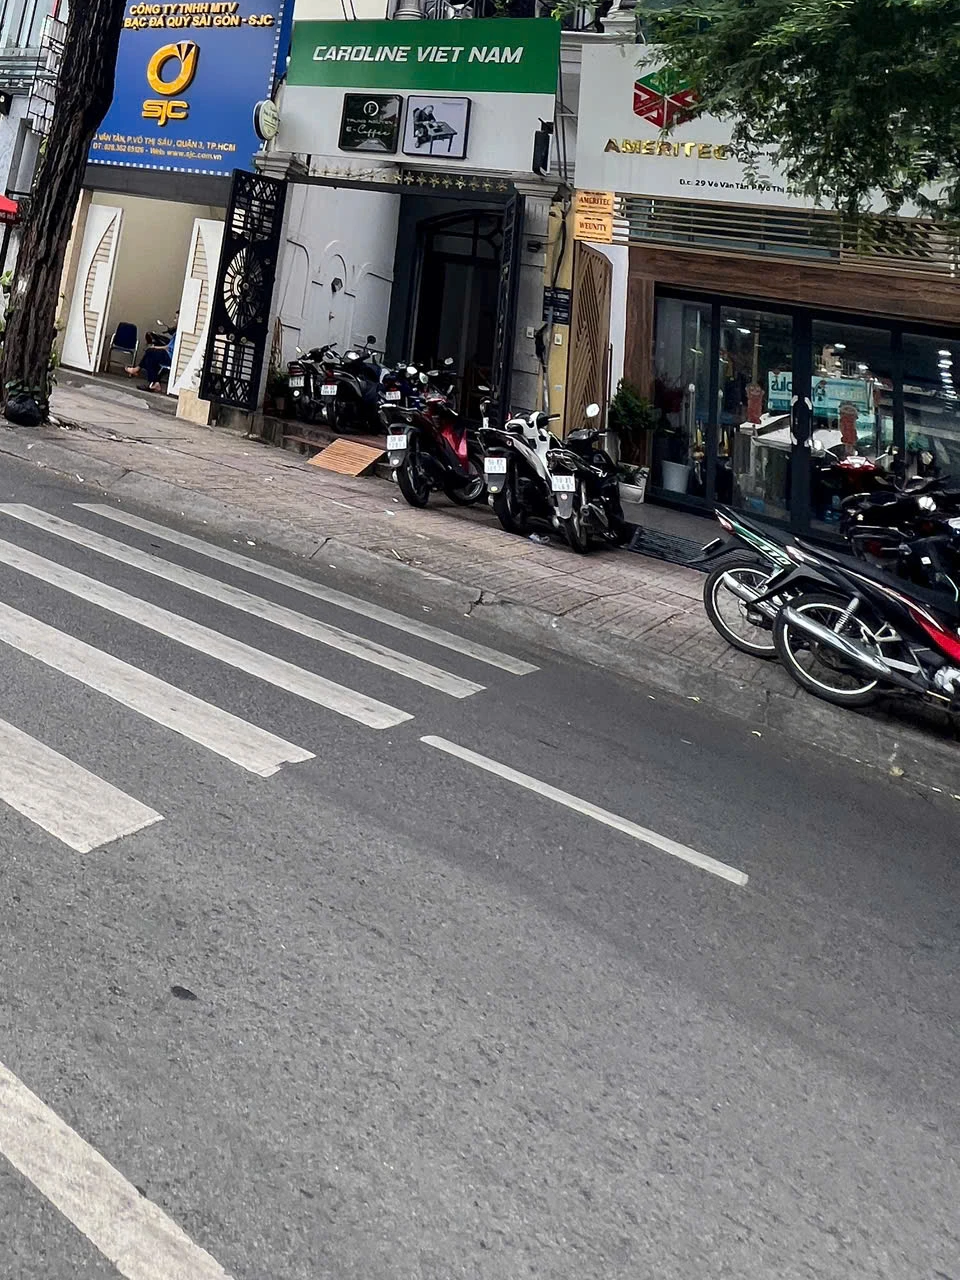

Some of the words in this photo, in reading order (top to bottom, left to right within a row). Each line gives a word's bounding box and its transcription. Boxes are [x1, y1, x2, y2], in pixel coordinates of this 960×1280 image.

[129, 2, 160, 15] CÔNG
[163, 3, 178, 14] TY
[178, 3, 209, 14] TNHH
[210, 2, 238, 14] MTV
[124, 16, 147, 31] BẠC
[148, 14, 164, 28] ĐÁ
[166, 13, 191, 28] QUÝ
[191, 13, 211, 27] SÀI
[213, 12, 240, 27] GÒN
[248, 15, 274, 27] SJC
[312, 45, 411, 62] CAROLINE
[417, 46, 465, 63] VIET
[467, 46, 524, 64] NAM
[141, 99, 189, 126] SJC
